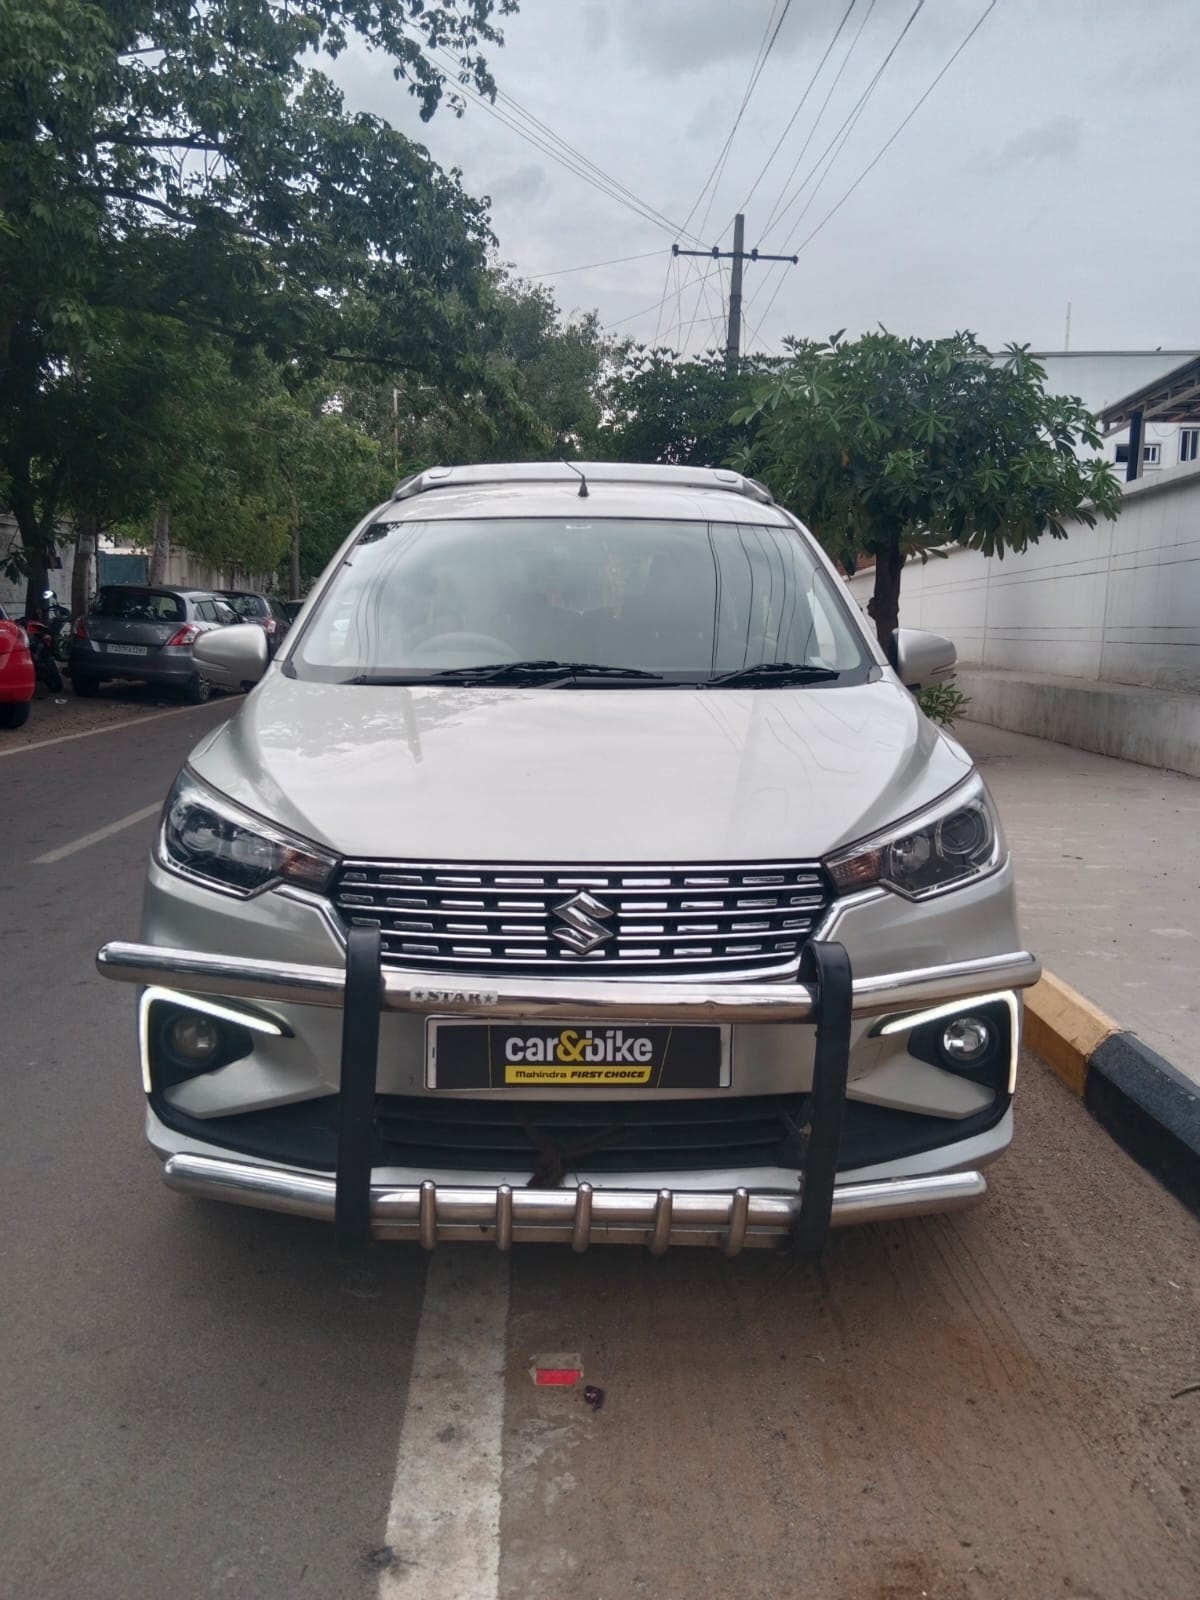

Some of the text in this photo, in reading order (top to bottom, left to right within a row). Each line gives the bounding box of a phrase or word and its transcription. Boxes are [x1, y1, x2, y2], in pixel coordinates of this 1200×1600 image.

[505, 1029, 653, 1062] car&bike
[515, 1070, 567, 1079] Mahindra
[570, 1071, 604, 1079] FIRST
